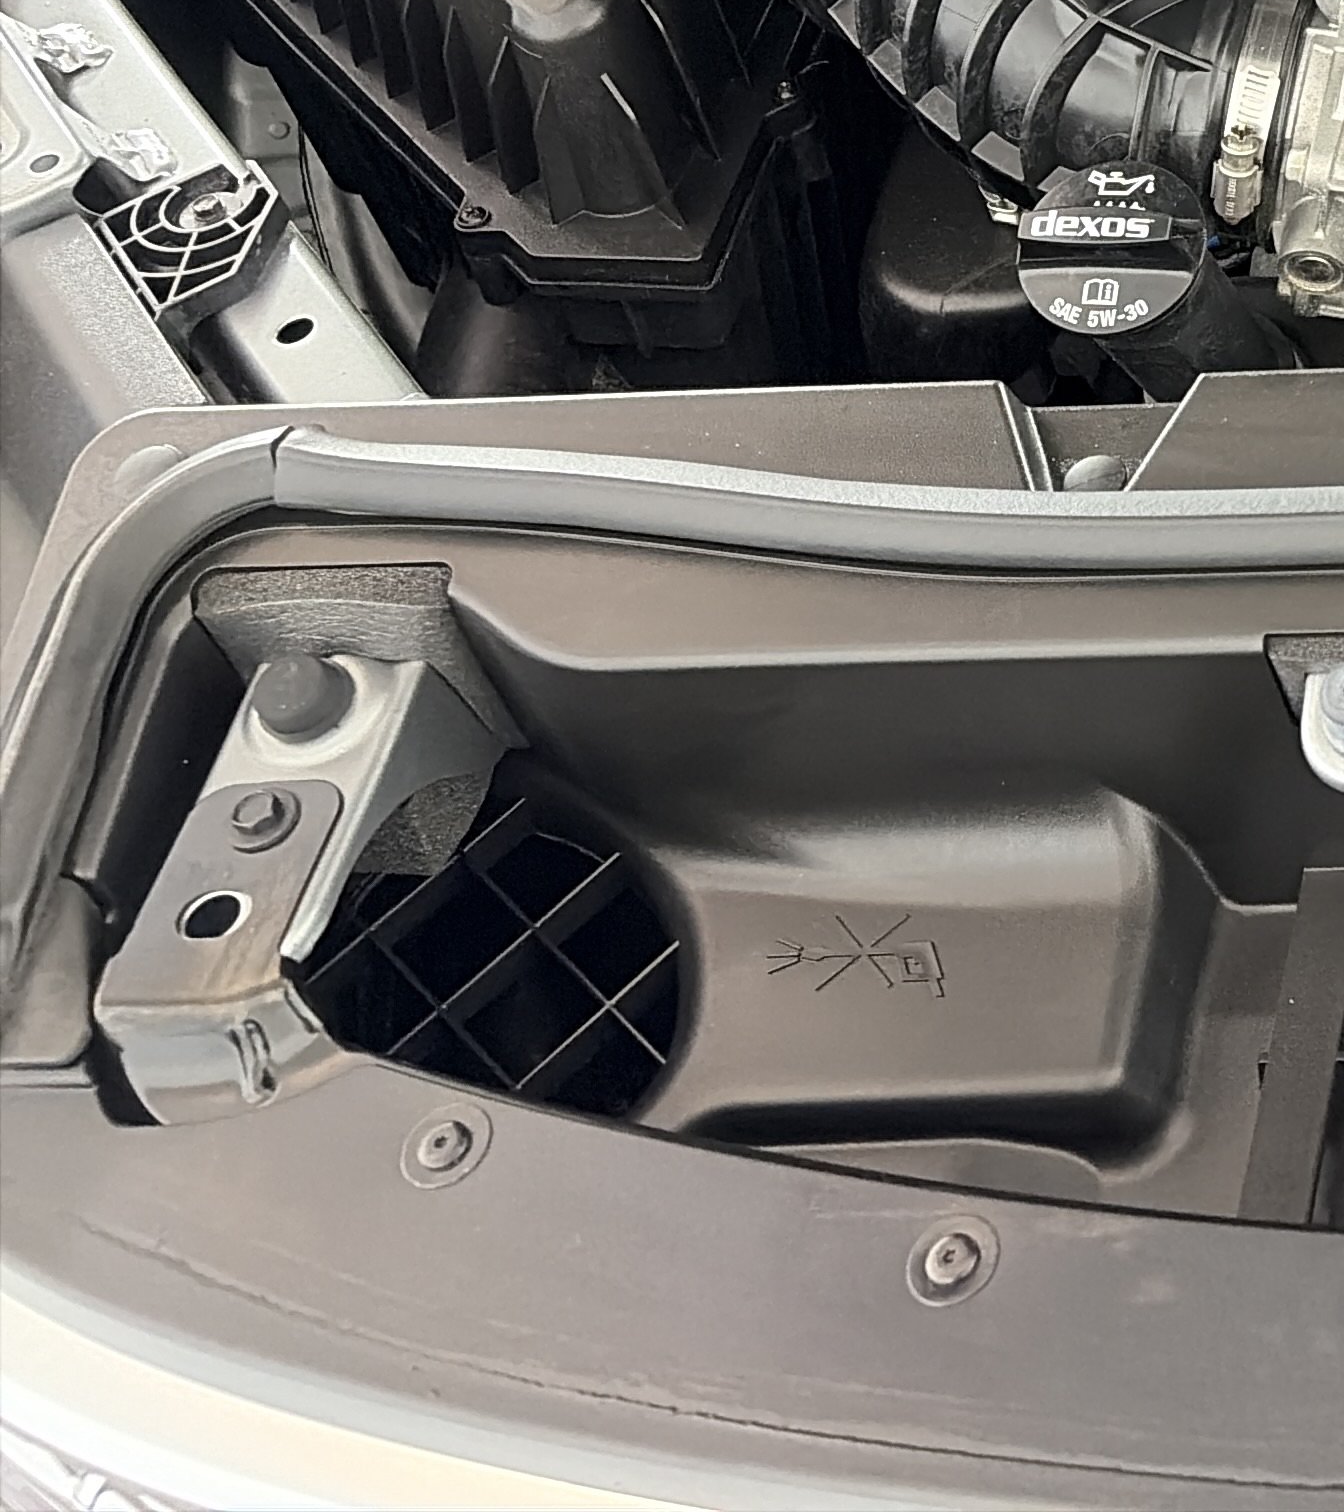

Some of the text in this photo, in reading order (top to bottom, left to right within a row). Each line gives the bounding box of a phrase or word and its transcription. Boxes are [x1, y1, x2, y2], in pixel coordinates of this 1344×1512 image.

[1031, 210, 1151, 238] dexos
[1049, 297, 1149, 328] SAE 5W-30
